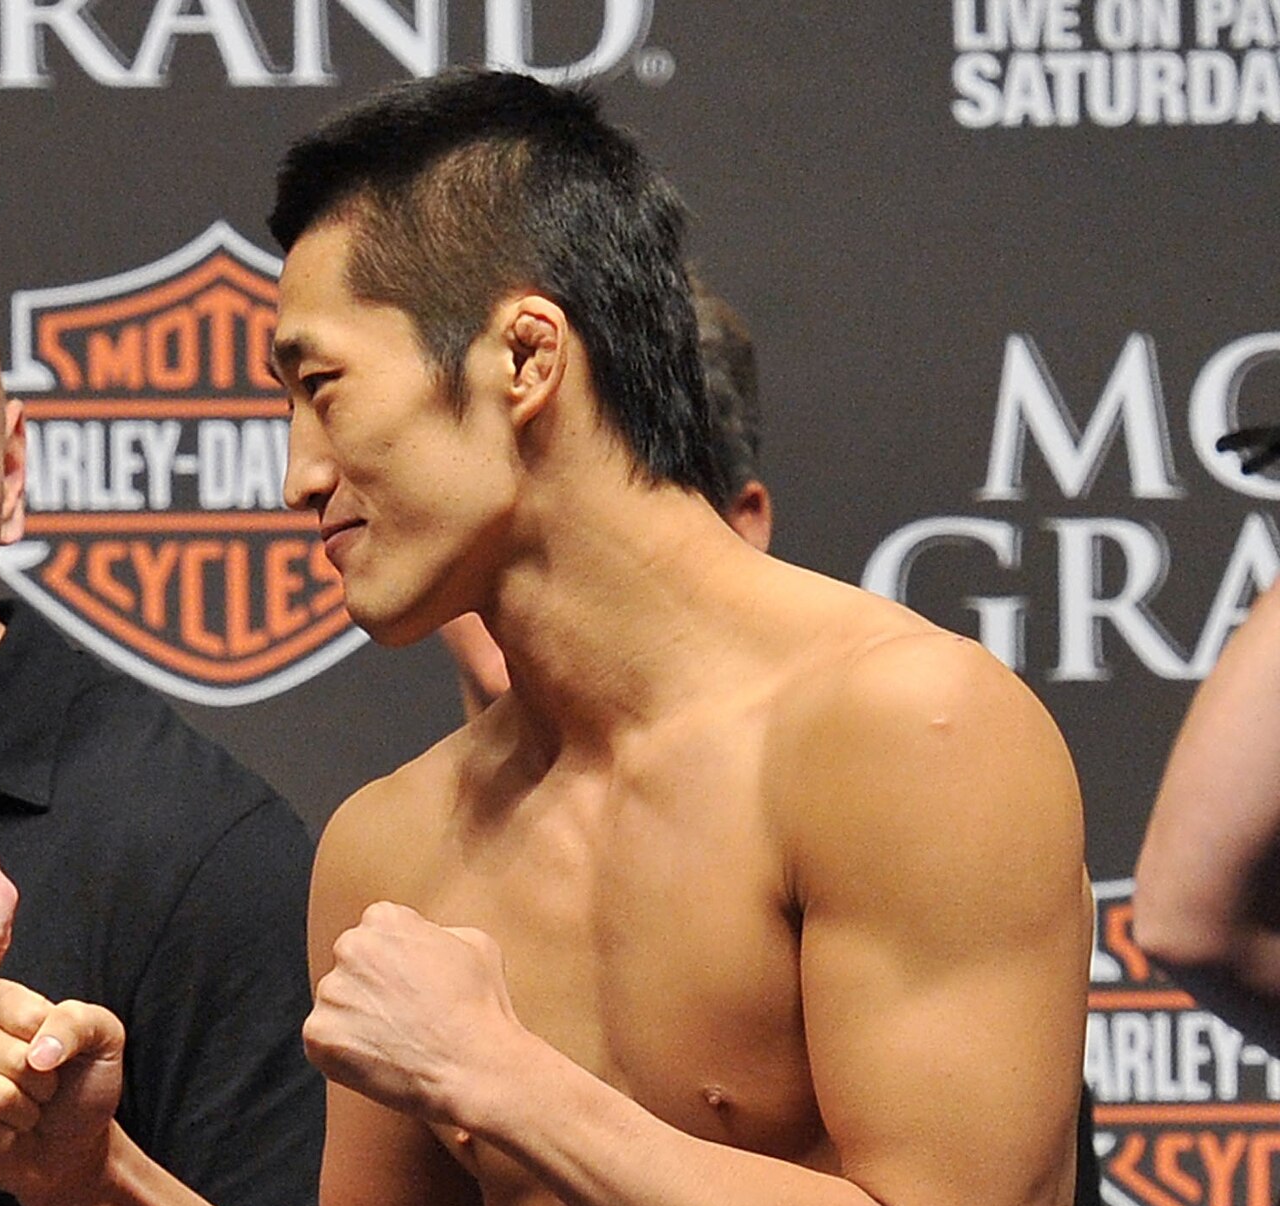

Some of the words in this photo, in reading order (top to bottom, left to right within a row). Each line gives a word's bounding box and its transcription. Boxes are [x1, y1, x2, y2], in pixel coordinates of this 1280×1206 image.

[953, 0, 1083, 50] LIVE
[1093, 0, 1183, 50] ON
[1195, 0, 1280, 50] PA
[1083, 1010, 1280, 1102] ARLEY-
